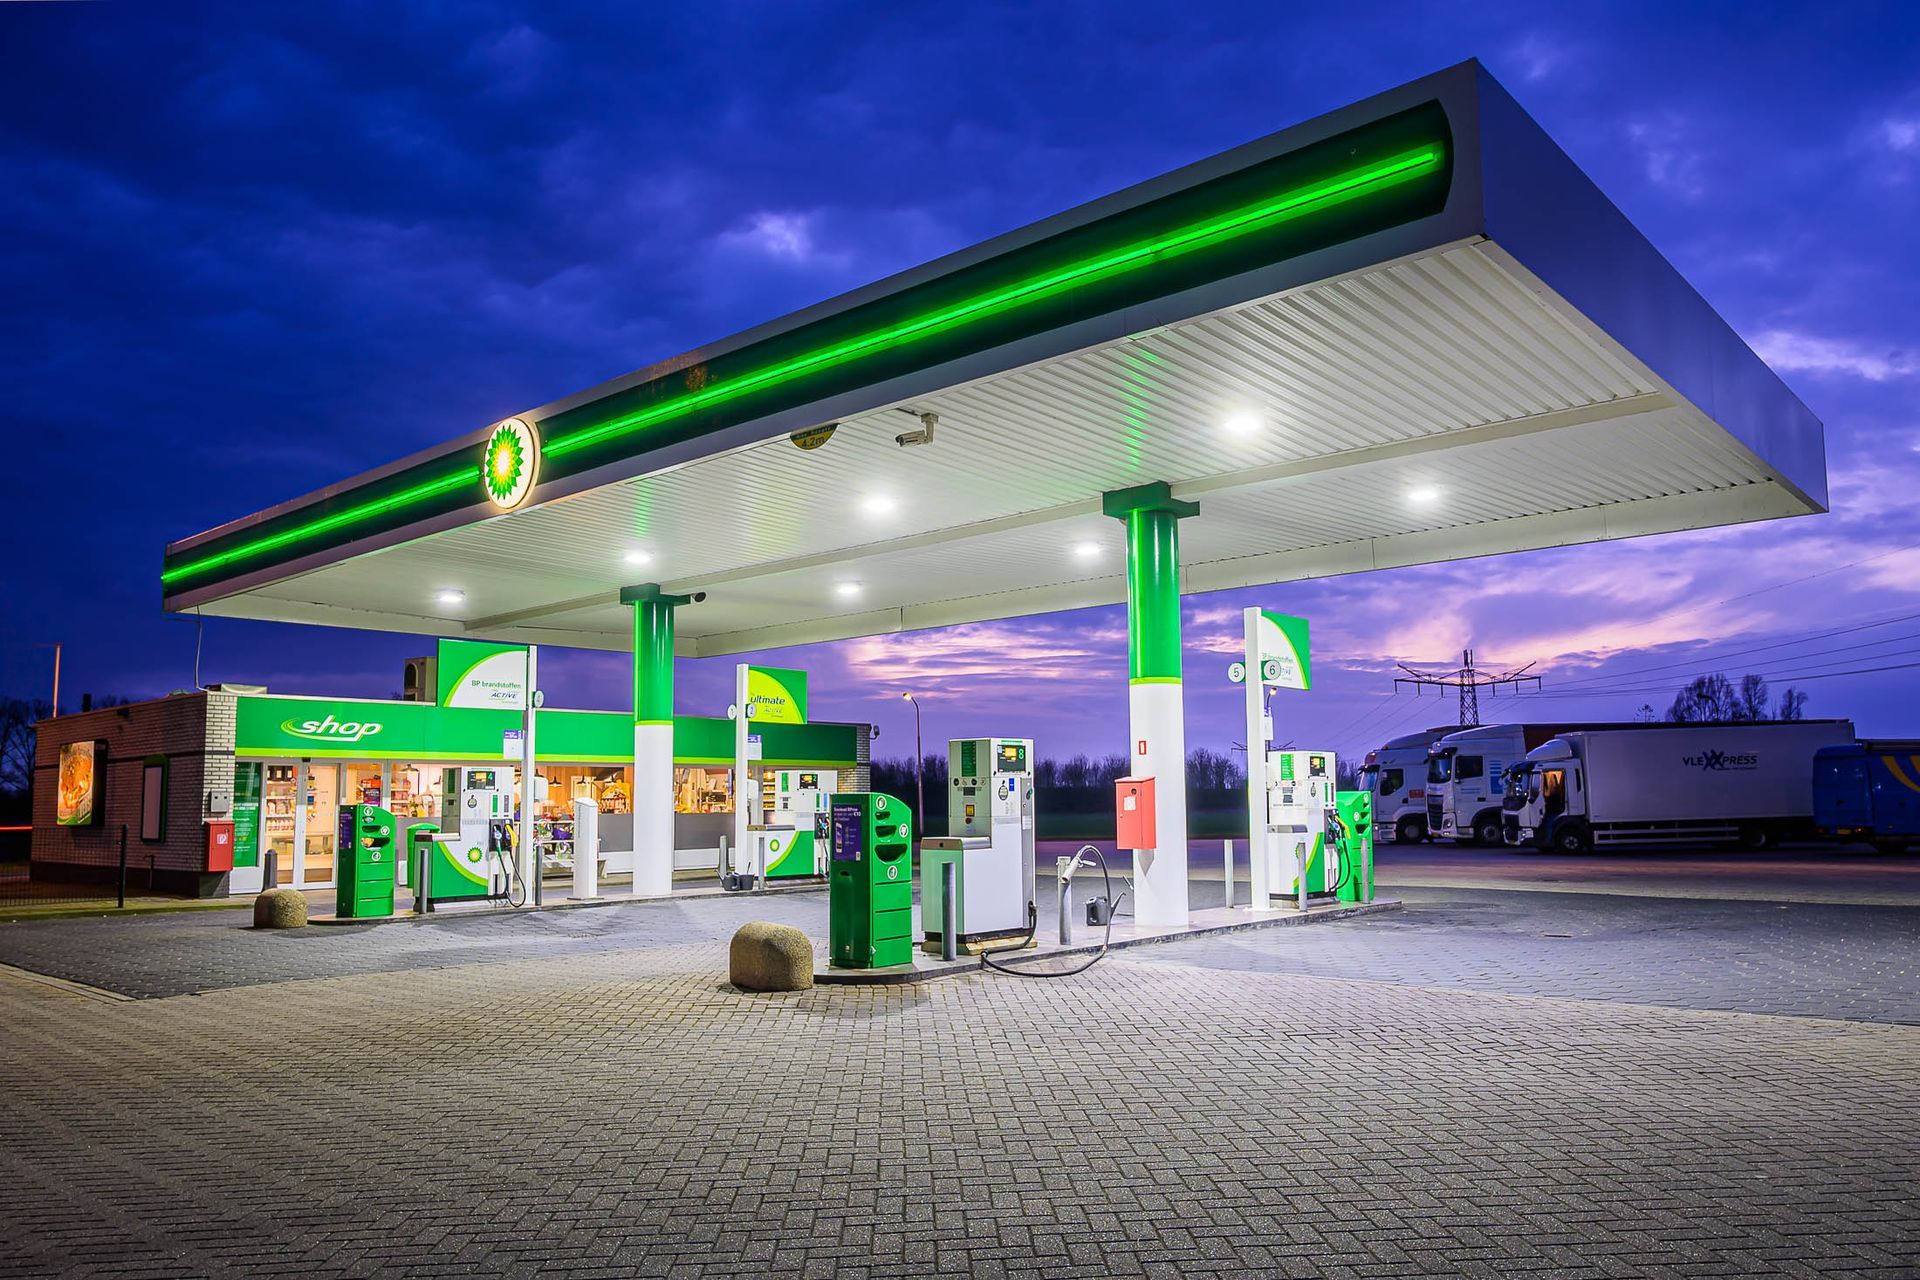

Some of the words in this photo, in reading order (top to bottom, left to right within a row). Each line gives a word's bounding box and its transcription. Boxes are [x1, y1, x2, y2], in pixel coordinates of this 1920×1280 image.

[802, 436, 825, 448] 4.2m
[1233, 667, 1239, 678] 5
[1269, 665, 1275, 675] 6
[482, 681, 521, 689] brandstoffen
[300, 714, 382, 741] shop
[1018, 749, 1024, 760] 8
[487, 772, 494, 781] 4
